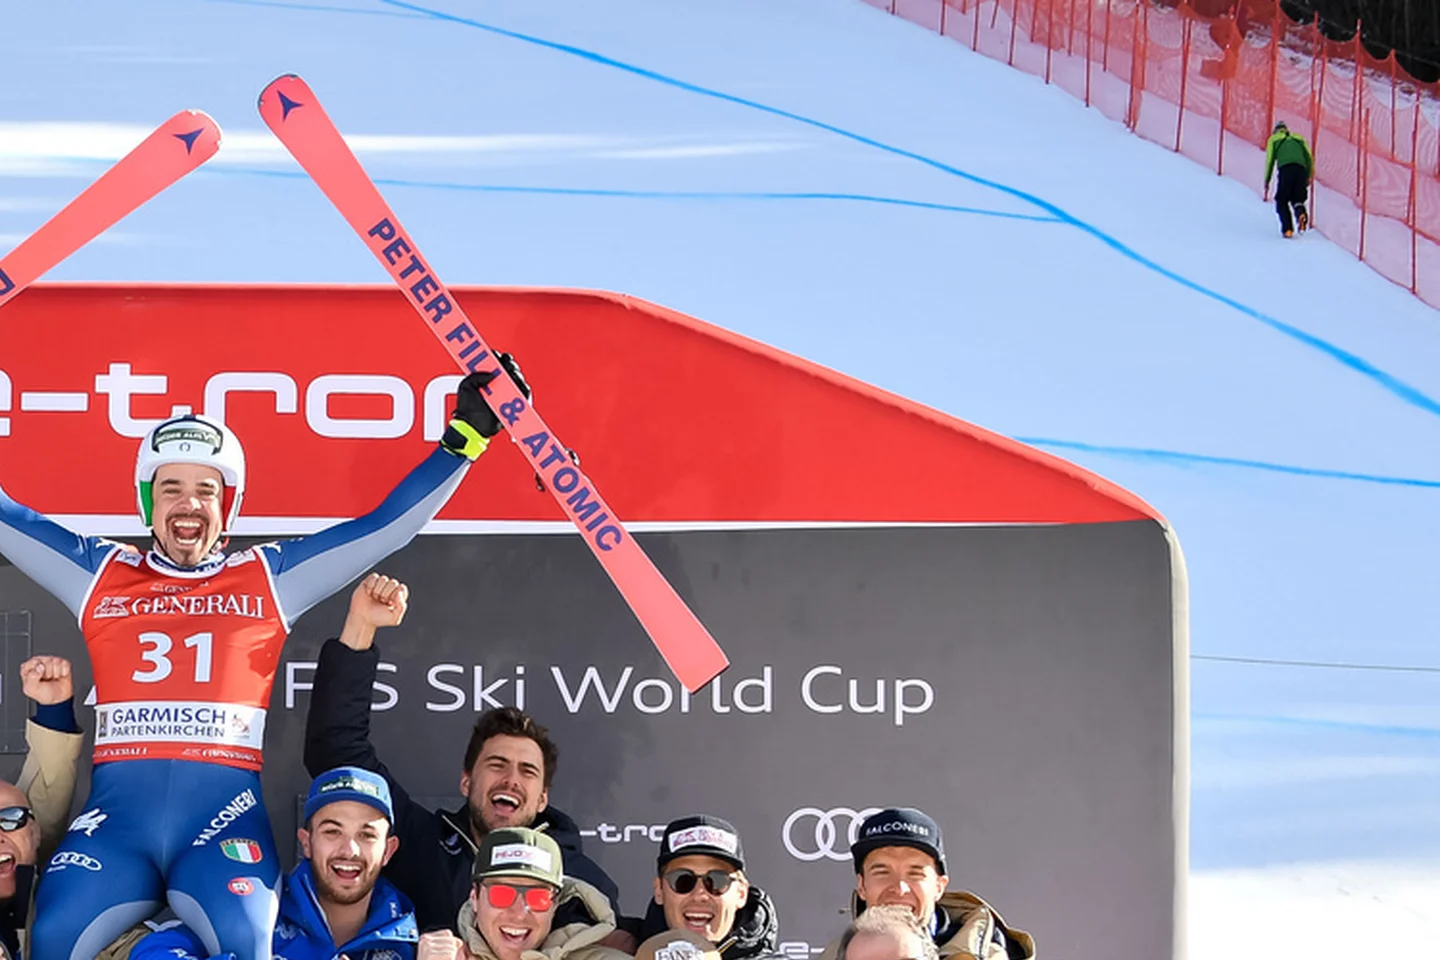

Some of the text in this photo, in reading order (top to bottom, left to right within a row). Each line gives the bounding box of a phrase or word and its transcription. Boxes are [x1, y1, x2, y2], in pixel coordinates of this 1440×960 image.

[367, 218, 452, 324] PETER
[499, 397, 525, 427] &
[521, 431, 623, 553] ATOMIC
[131, 594, 265, 619] GENERALI
[131, 632, 213, 683] 31
[284, 661, 934, 726] FS Ski World Cup
[112, 707, 226, 725] GARMISCH
[110, 724, 227, 738] PARTENKIRCHEN
[865, 820, 929, 837] FALCONERI
